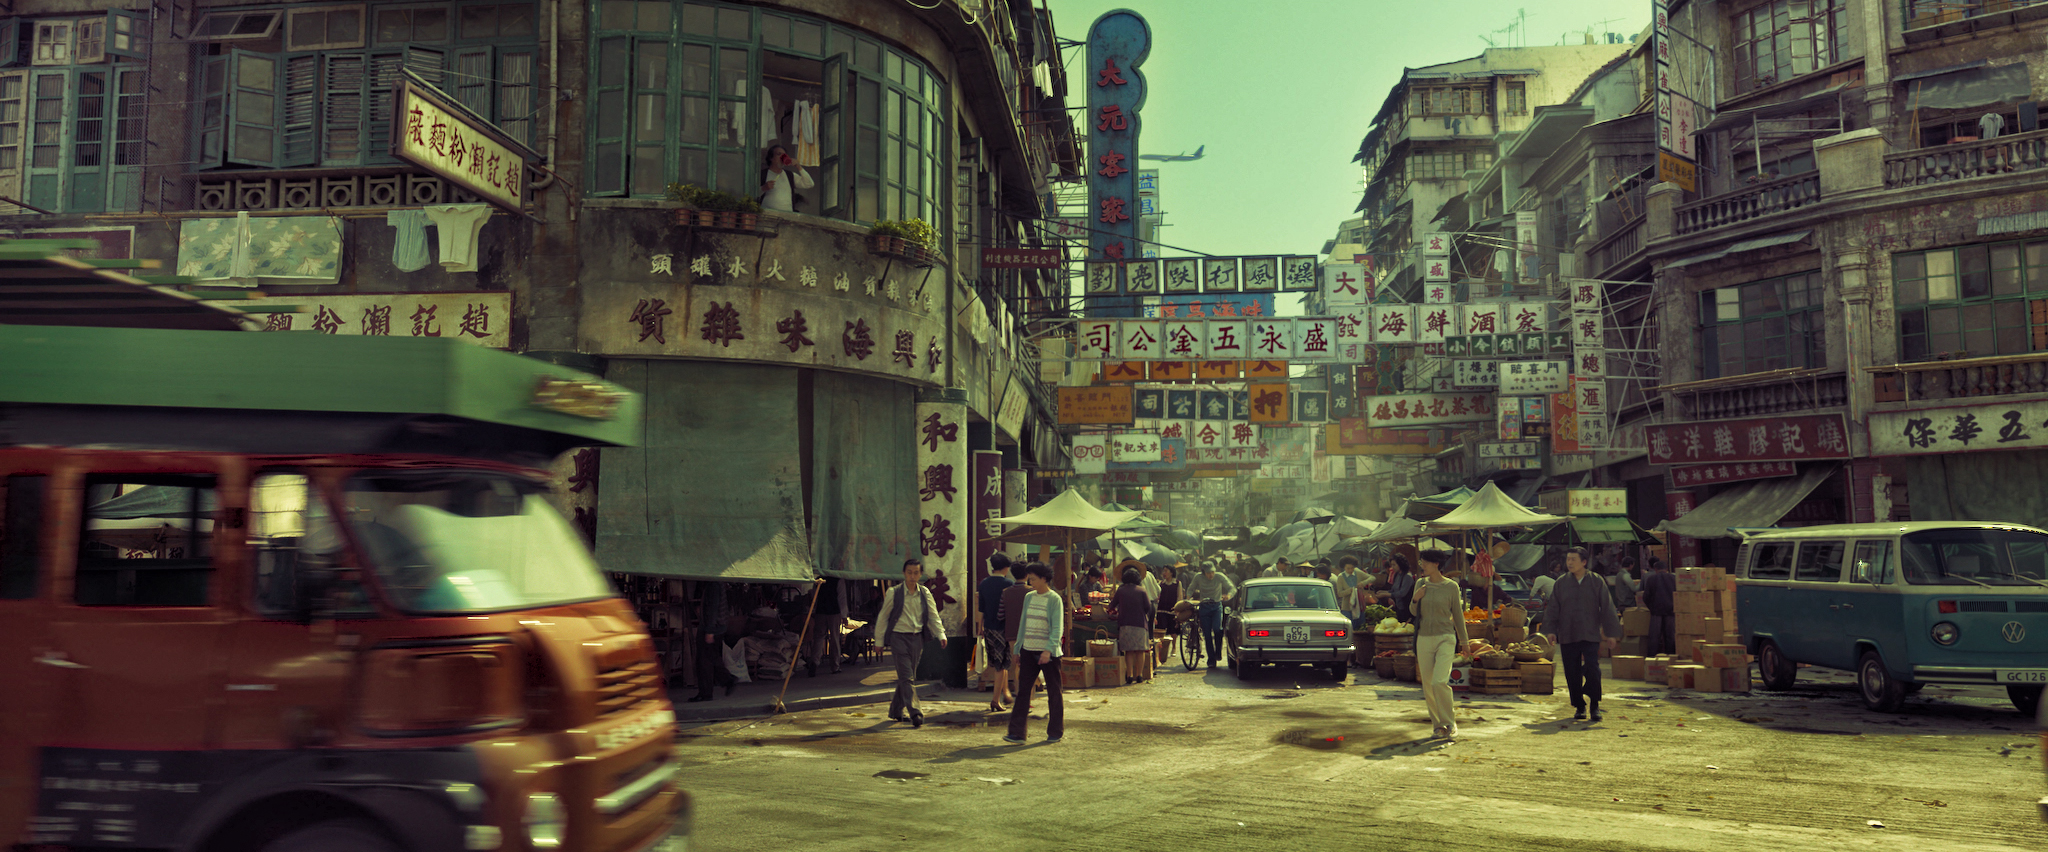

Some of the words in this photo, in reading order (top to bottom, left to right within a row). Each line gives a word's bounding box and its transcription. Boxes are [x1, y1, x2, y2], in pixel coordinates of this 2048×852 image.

[1254, 389, 1283, 418] 押
[1903, 410, 2048, 448] 保華五
